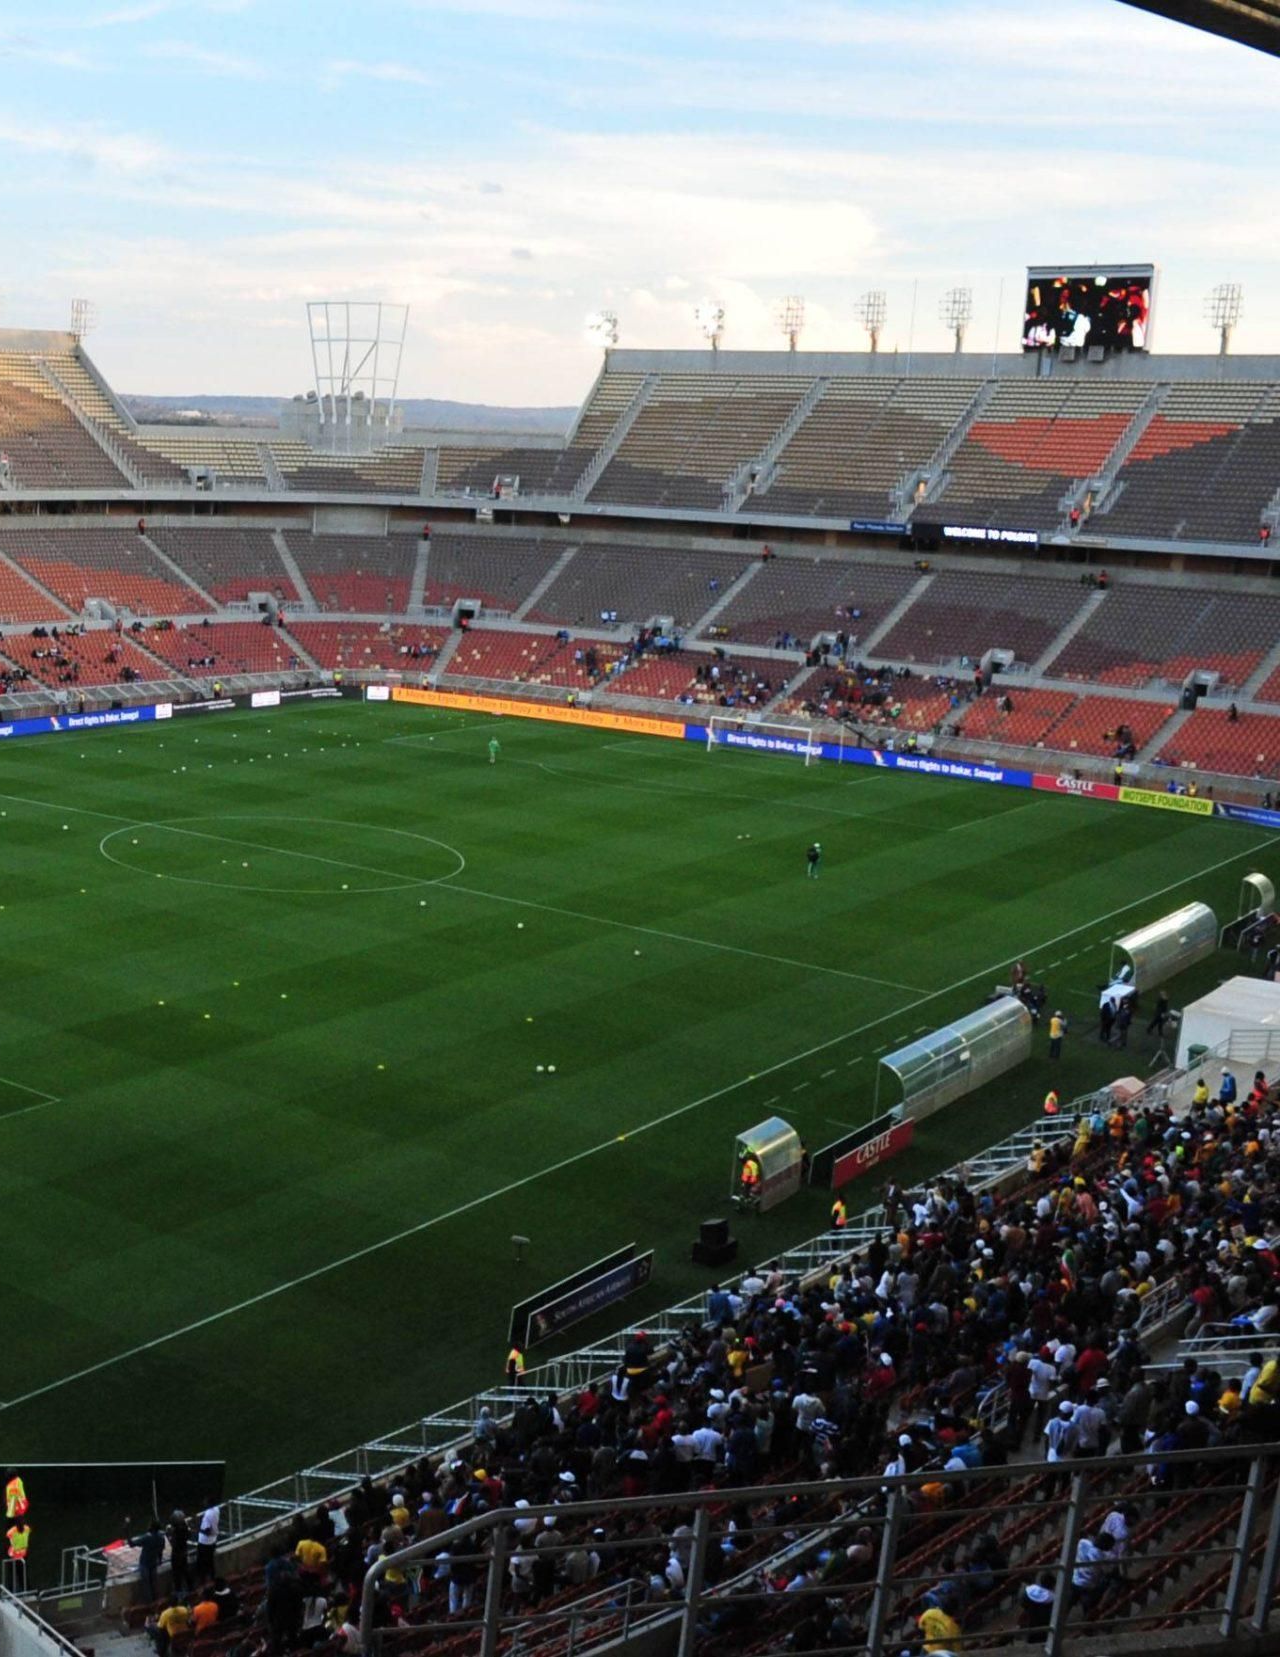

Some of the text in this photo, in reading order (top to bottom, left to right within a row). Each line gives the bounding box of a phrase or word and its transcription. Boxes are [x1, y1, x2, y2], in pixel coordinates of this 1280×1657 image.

[944, 526, 986, 539] WELCOME
[987, 528, 1000, 540] TO
[69, 717, 84, 727] Direct
[99, 715, 105, 724] to
[120, 710, 139, 721] Senegal
[727, 733, 746, 744] Direct
[747, 736, 767, 748] flights
[767, 739, 775, 748] to
[897, 757, 918, 768] Direct
[919, 760, 940, 772] flights
[942, 764, 950, 773] to
[974, 768, 1003, 782] Senegal
[1055, 776, 1095, 792] CASTLE
[1158, 793, 1210, 813] FOUNDATION
[856, 1132, 892, 1164] CASTLE
